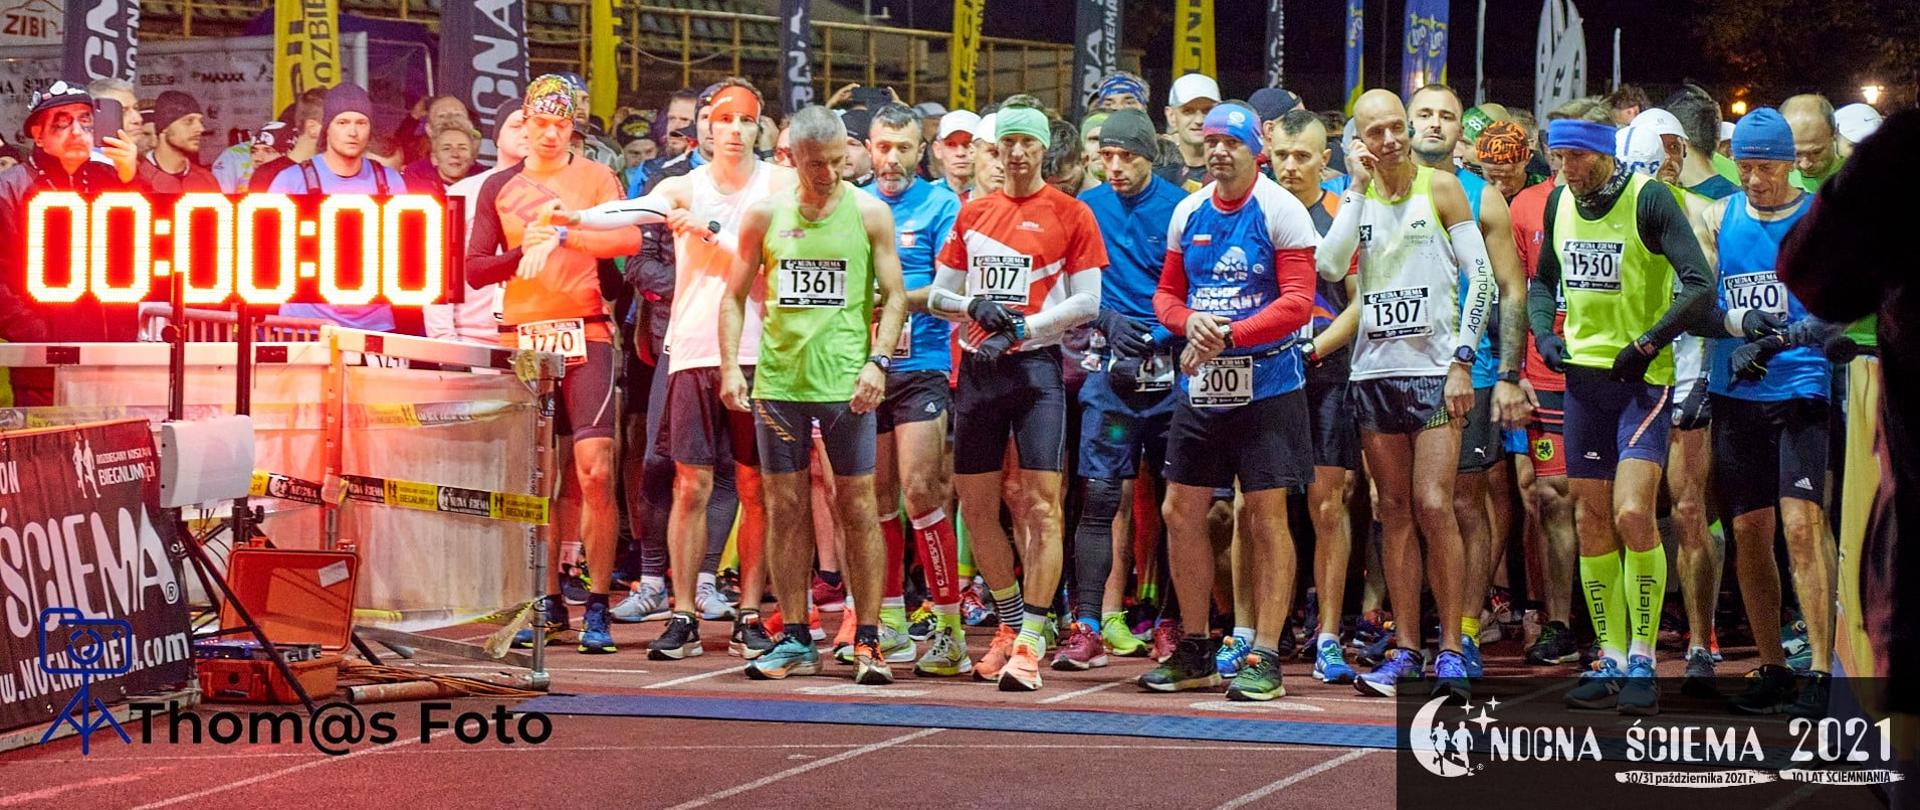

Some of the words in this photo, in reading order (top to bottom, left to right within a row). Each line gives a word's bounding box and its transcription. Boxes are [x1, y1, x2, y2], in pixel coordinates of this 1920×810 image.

[3, 14, 48, 38] ZIBI
[27, 191, 444, 305] 00:00:00
[1569, 253, 1613, 277] 1530
[791, 270, 836, 294] 1361
[980, 267, 1020, 290] 1017
[1729, 284, 1779, 310] 1460
[1373, 299, 1421, 327] 1307
[0, 502, 177, 638] ŚCIEMA
